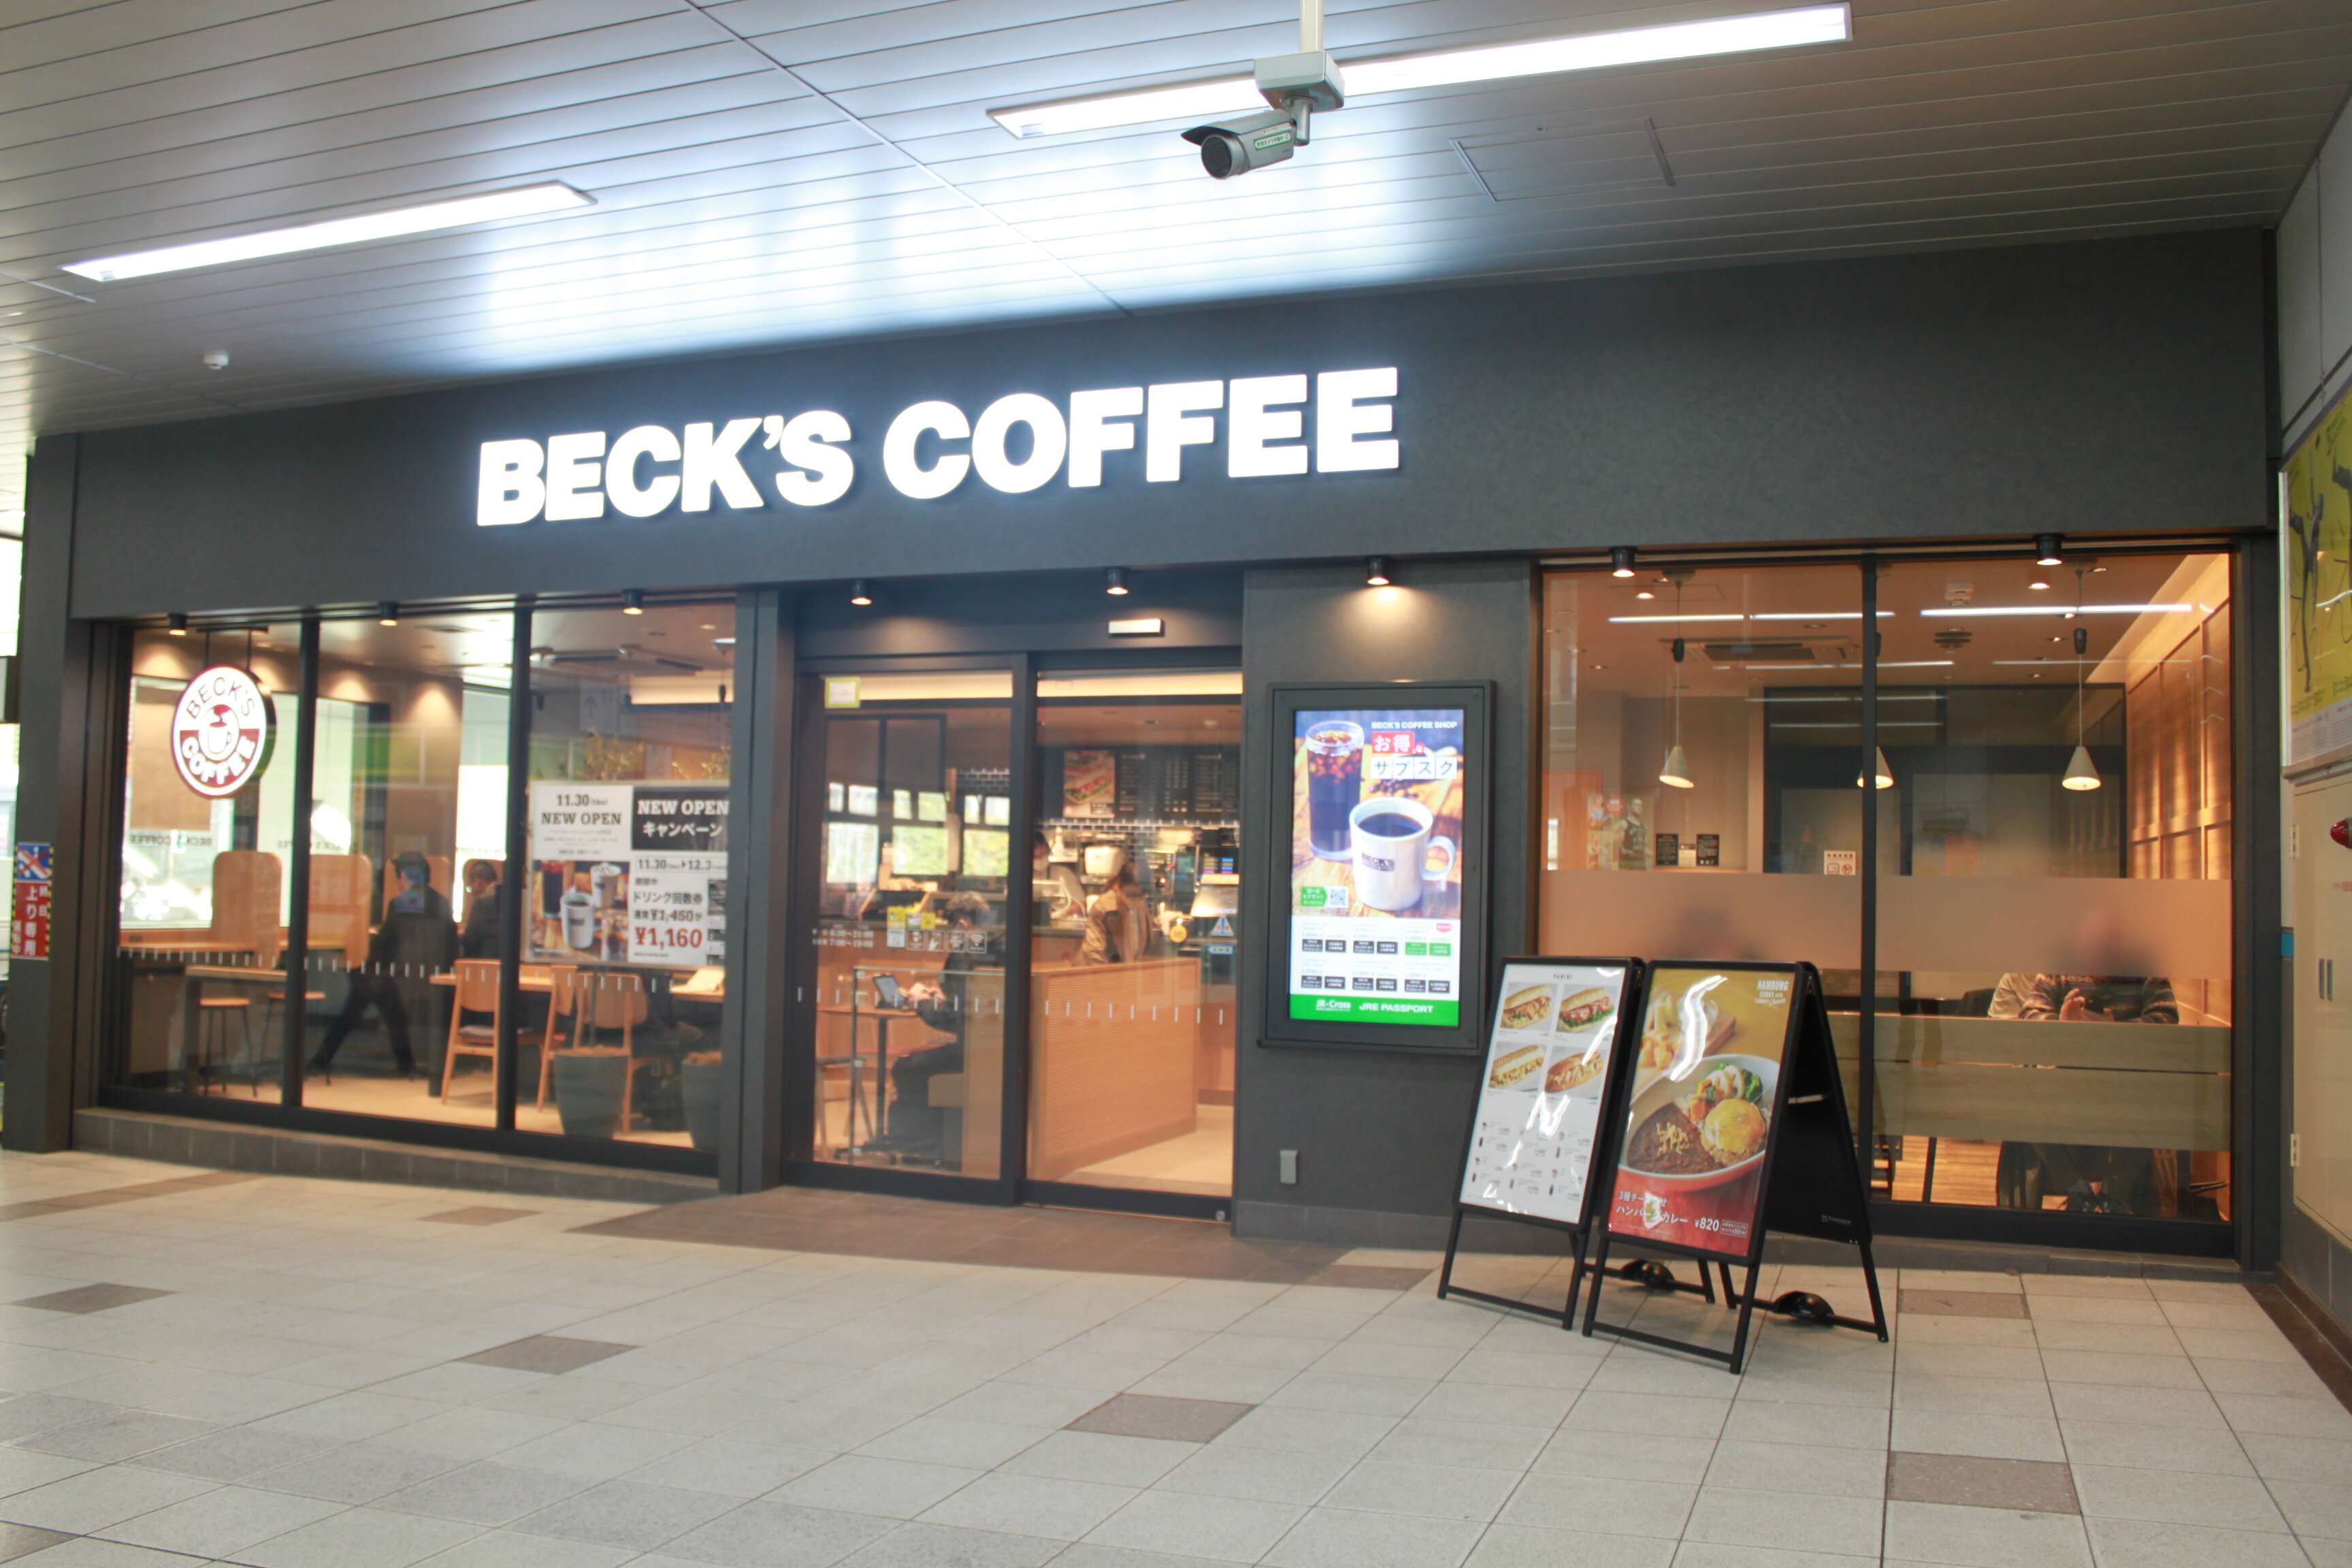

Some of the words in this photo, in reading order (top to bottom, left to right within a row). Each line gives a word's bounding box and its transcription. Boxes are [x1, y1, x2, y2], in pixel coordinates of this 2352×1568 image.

[477, 410, 854, 526] BECK'S
[883, 368, 1399, 499] COFFEE
[186, 676, 255, 720] BECK'S
[1371, 721, 1401, 730] BECK'S
[1401, 721, 1433, 730] COFFEE
[1433, 721, 1458, 729] SHOP
[1374, 734, 1411, 753] お得
[182, 735, 257, 785] COFFEE
[1375, 761, 1454, 776] サブスク
[556, 794, 590, 806] 11.30
[637, 799, 679, 815] NEW
[681, 799, 730, 815] OPEN
[541, 813, 577, 825] NEW
[581, 813, 622, 826] OPEN
[642, 821, 723, 838] キャンペーン
[638, 859, 666, 869] 11.30
[688, 860, 712, 870] 12.3
[634, 926, 703, 949] ¥1,160
[1757, 980, 1789, 992] HAMBURG
[1358, 1002, 1379, 1011] JRE
[1380, 1003, 1434, 1013] PASSPORT
[1695, 1217, 1720, 1231] ¥820
